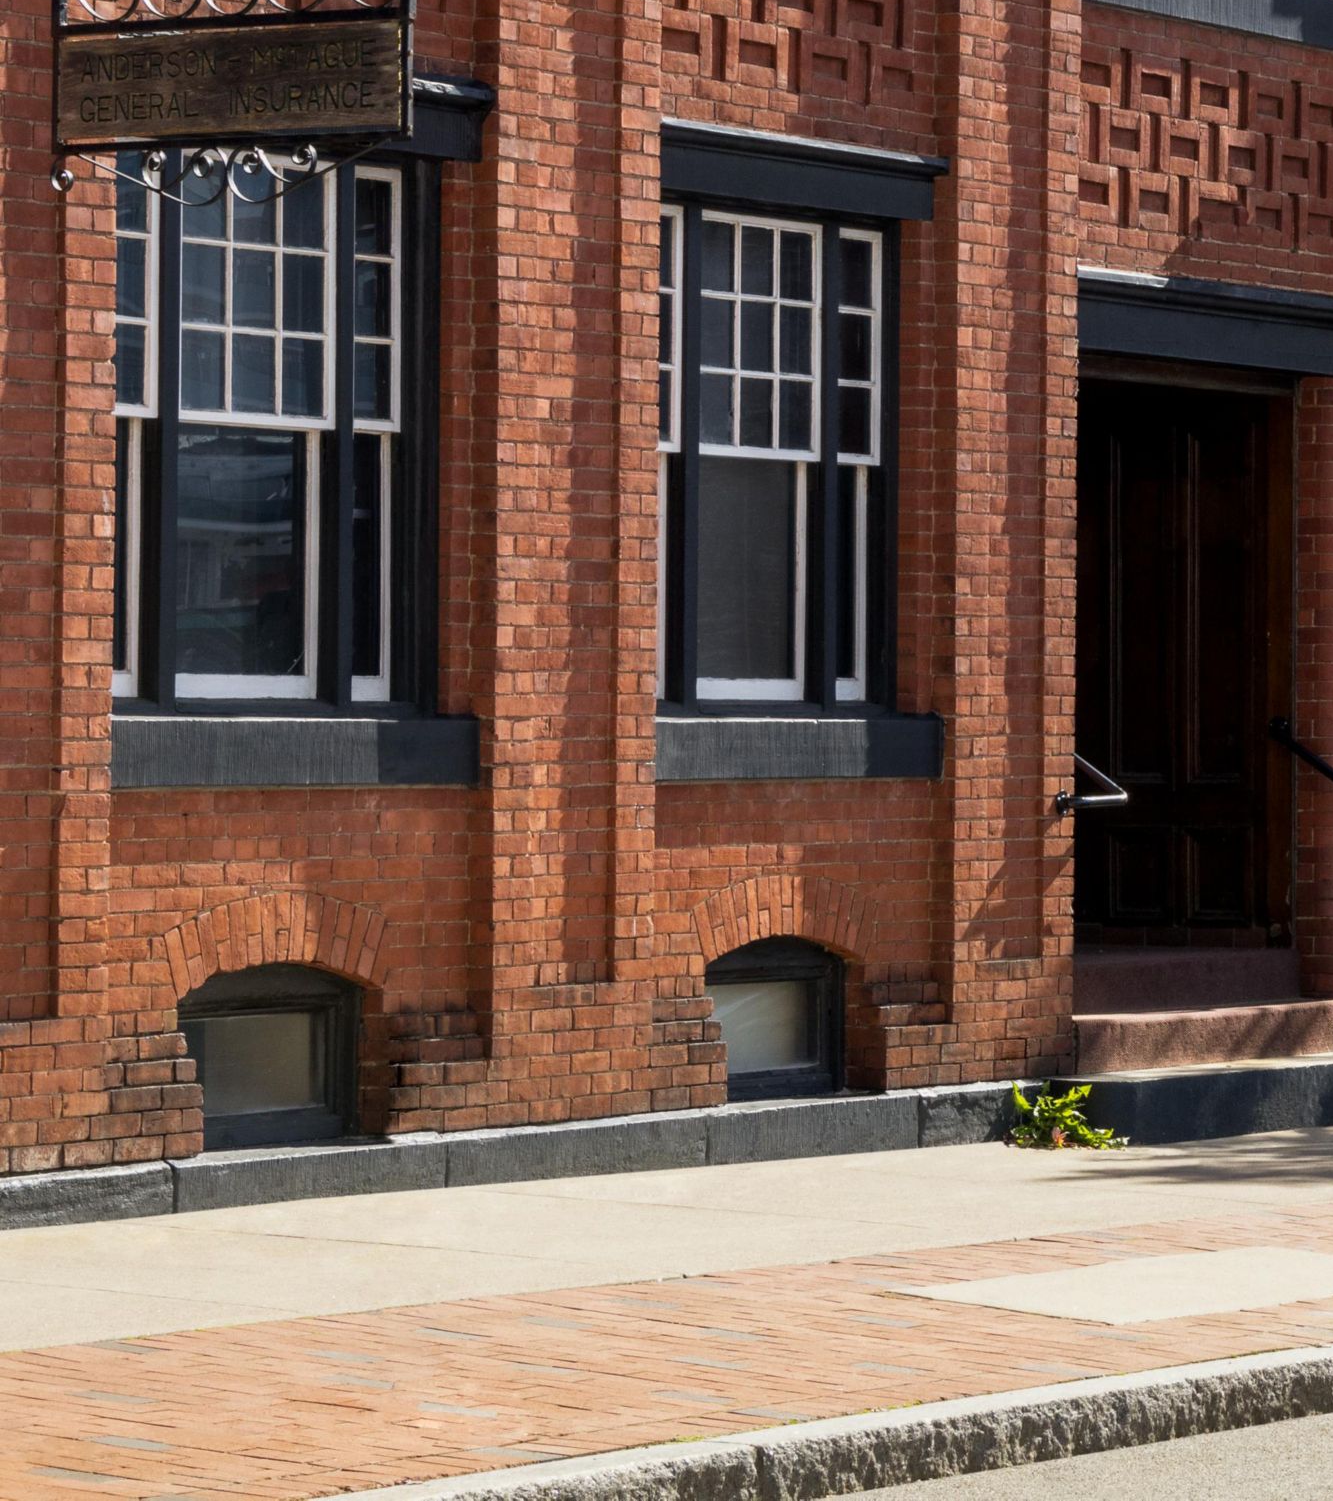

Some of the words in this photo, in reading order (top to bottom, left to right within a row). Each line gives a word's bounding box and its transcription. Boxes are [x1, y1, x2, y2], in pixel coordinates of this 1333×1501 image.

[80, 50, 217, 83] ANDERSON
[79, 91, 199, 123] GENERAL
[228, 81, 377, 116] INSURANCE
